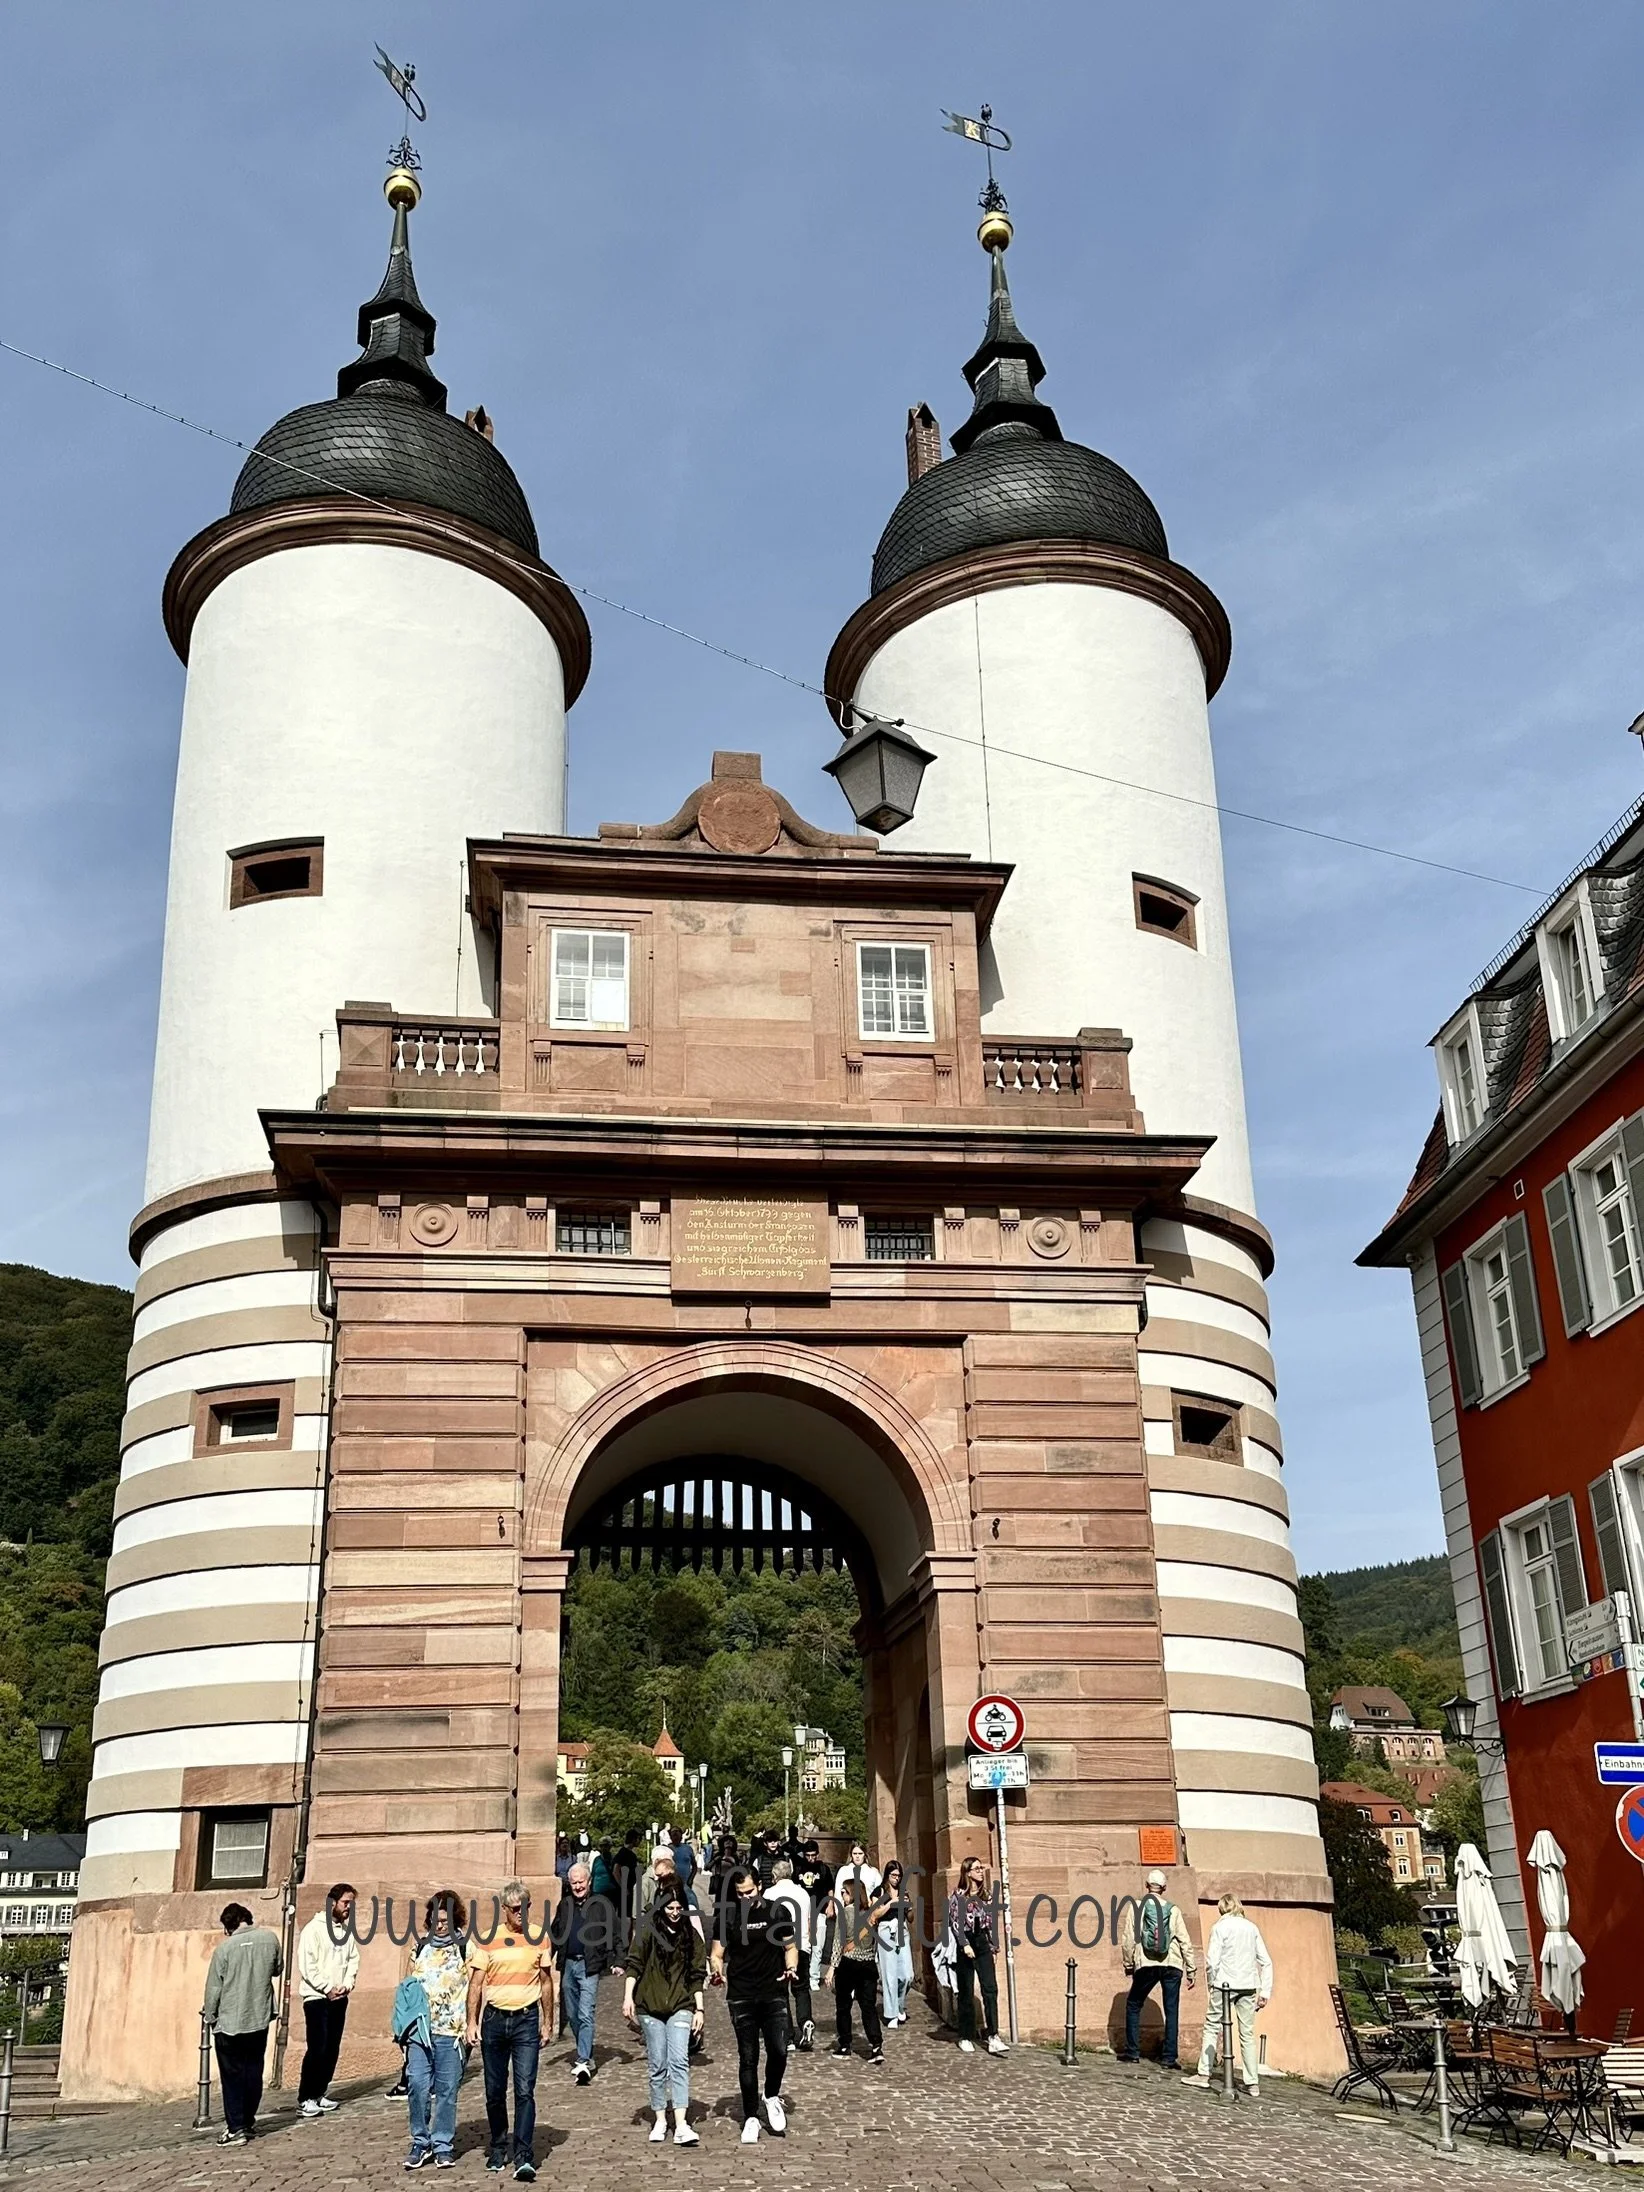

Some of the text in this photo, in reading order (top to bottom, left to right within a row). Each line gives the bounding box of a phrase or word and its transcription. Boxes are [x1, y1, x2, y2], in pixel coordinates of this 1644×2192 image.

[716, 1207, 756, 1217] Oktober
[757, 1208, 778, 1219] 1799
[781, 1211, 812, 1221] gegen
[687, 1218, 704, 1228] den
[704, 1218, 747, 1230] Ansturm
[748, 1221, 764, 1229] der
[684, 1230, 699, 1240] mit
[765, 1231, 816, 1244] Tapferkeit
[687, 1241, 817, 1256] und siegreichem Erfolg das
[1604, 1758, 1644, 1769] Einbahn
